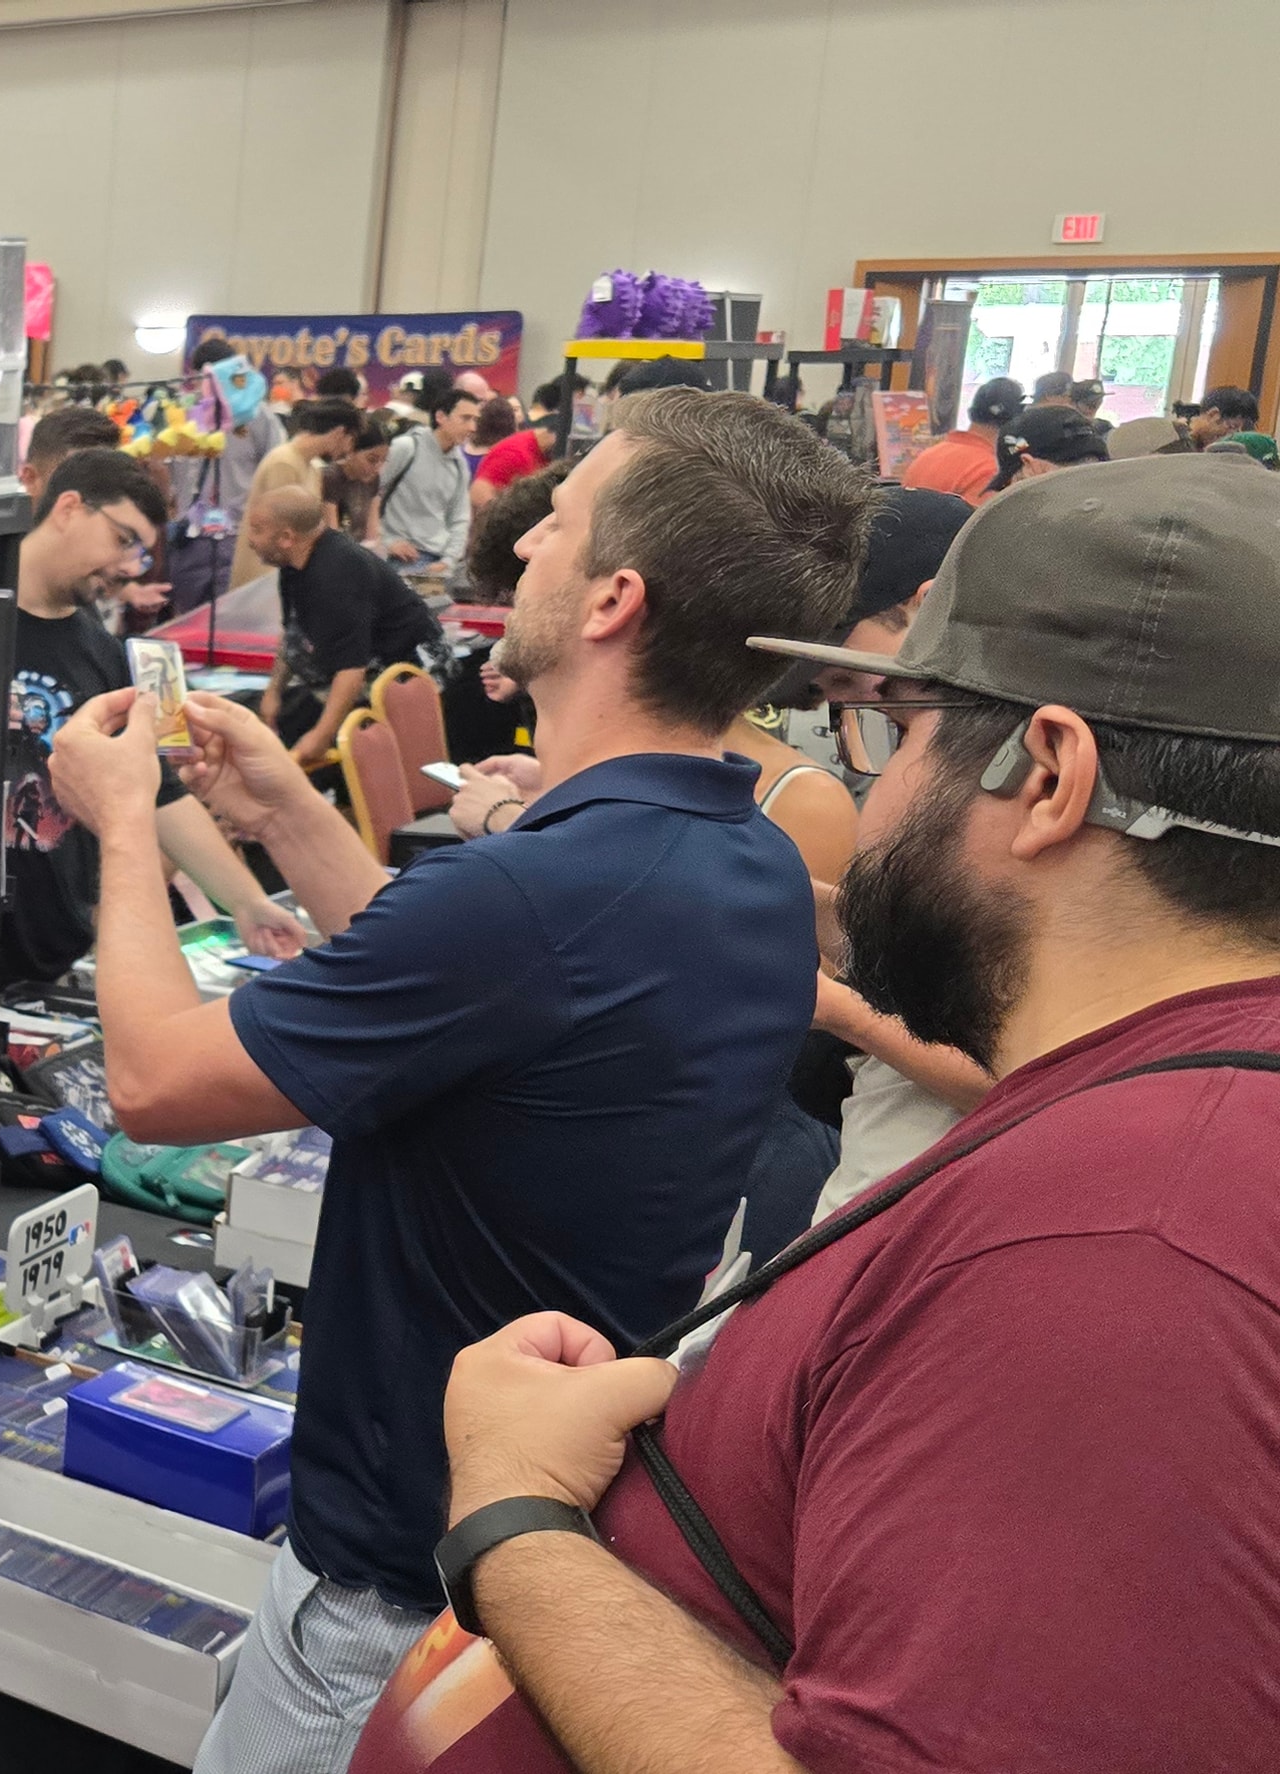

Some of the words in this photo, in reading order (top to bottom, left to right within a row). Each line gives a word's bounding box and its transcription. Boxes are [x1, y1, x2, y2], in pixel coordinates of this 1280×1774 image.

[1063, 215, 1099, 239] EXIT
[377, 323, 502, 367] Cards
[24, 1210, 68, 1253] 1950
[22, 1250, 65, 1297] 1979
